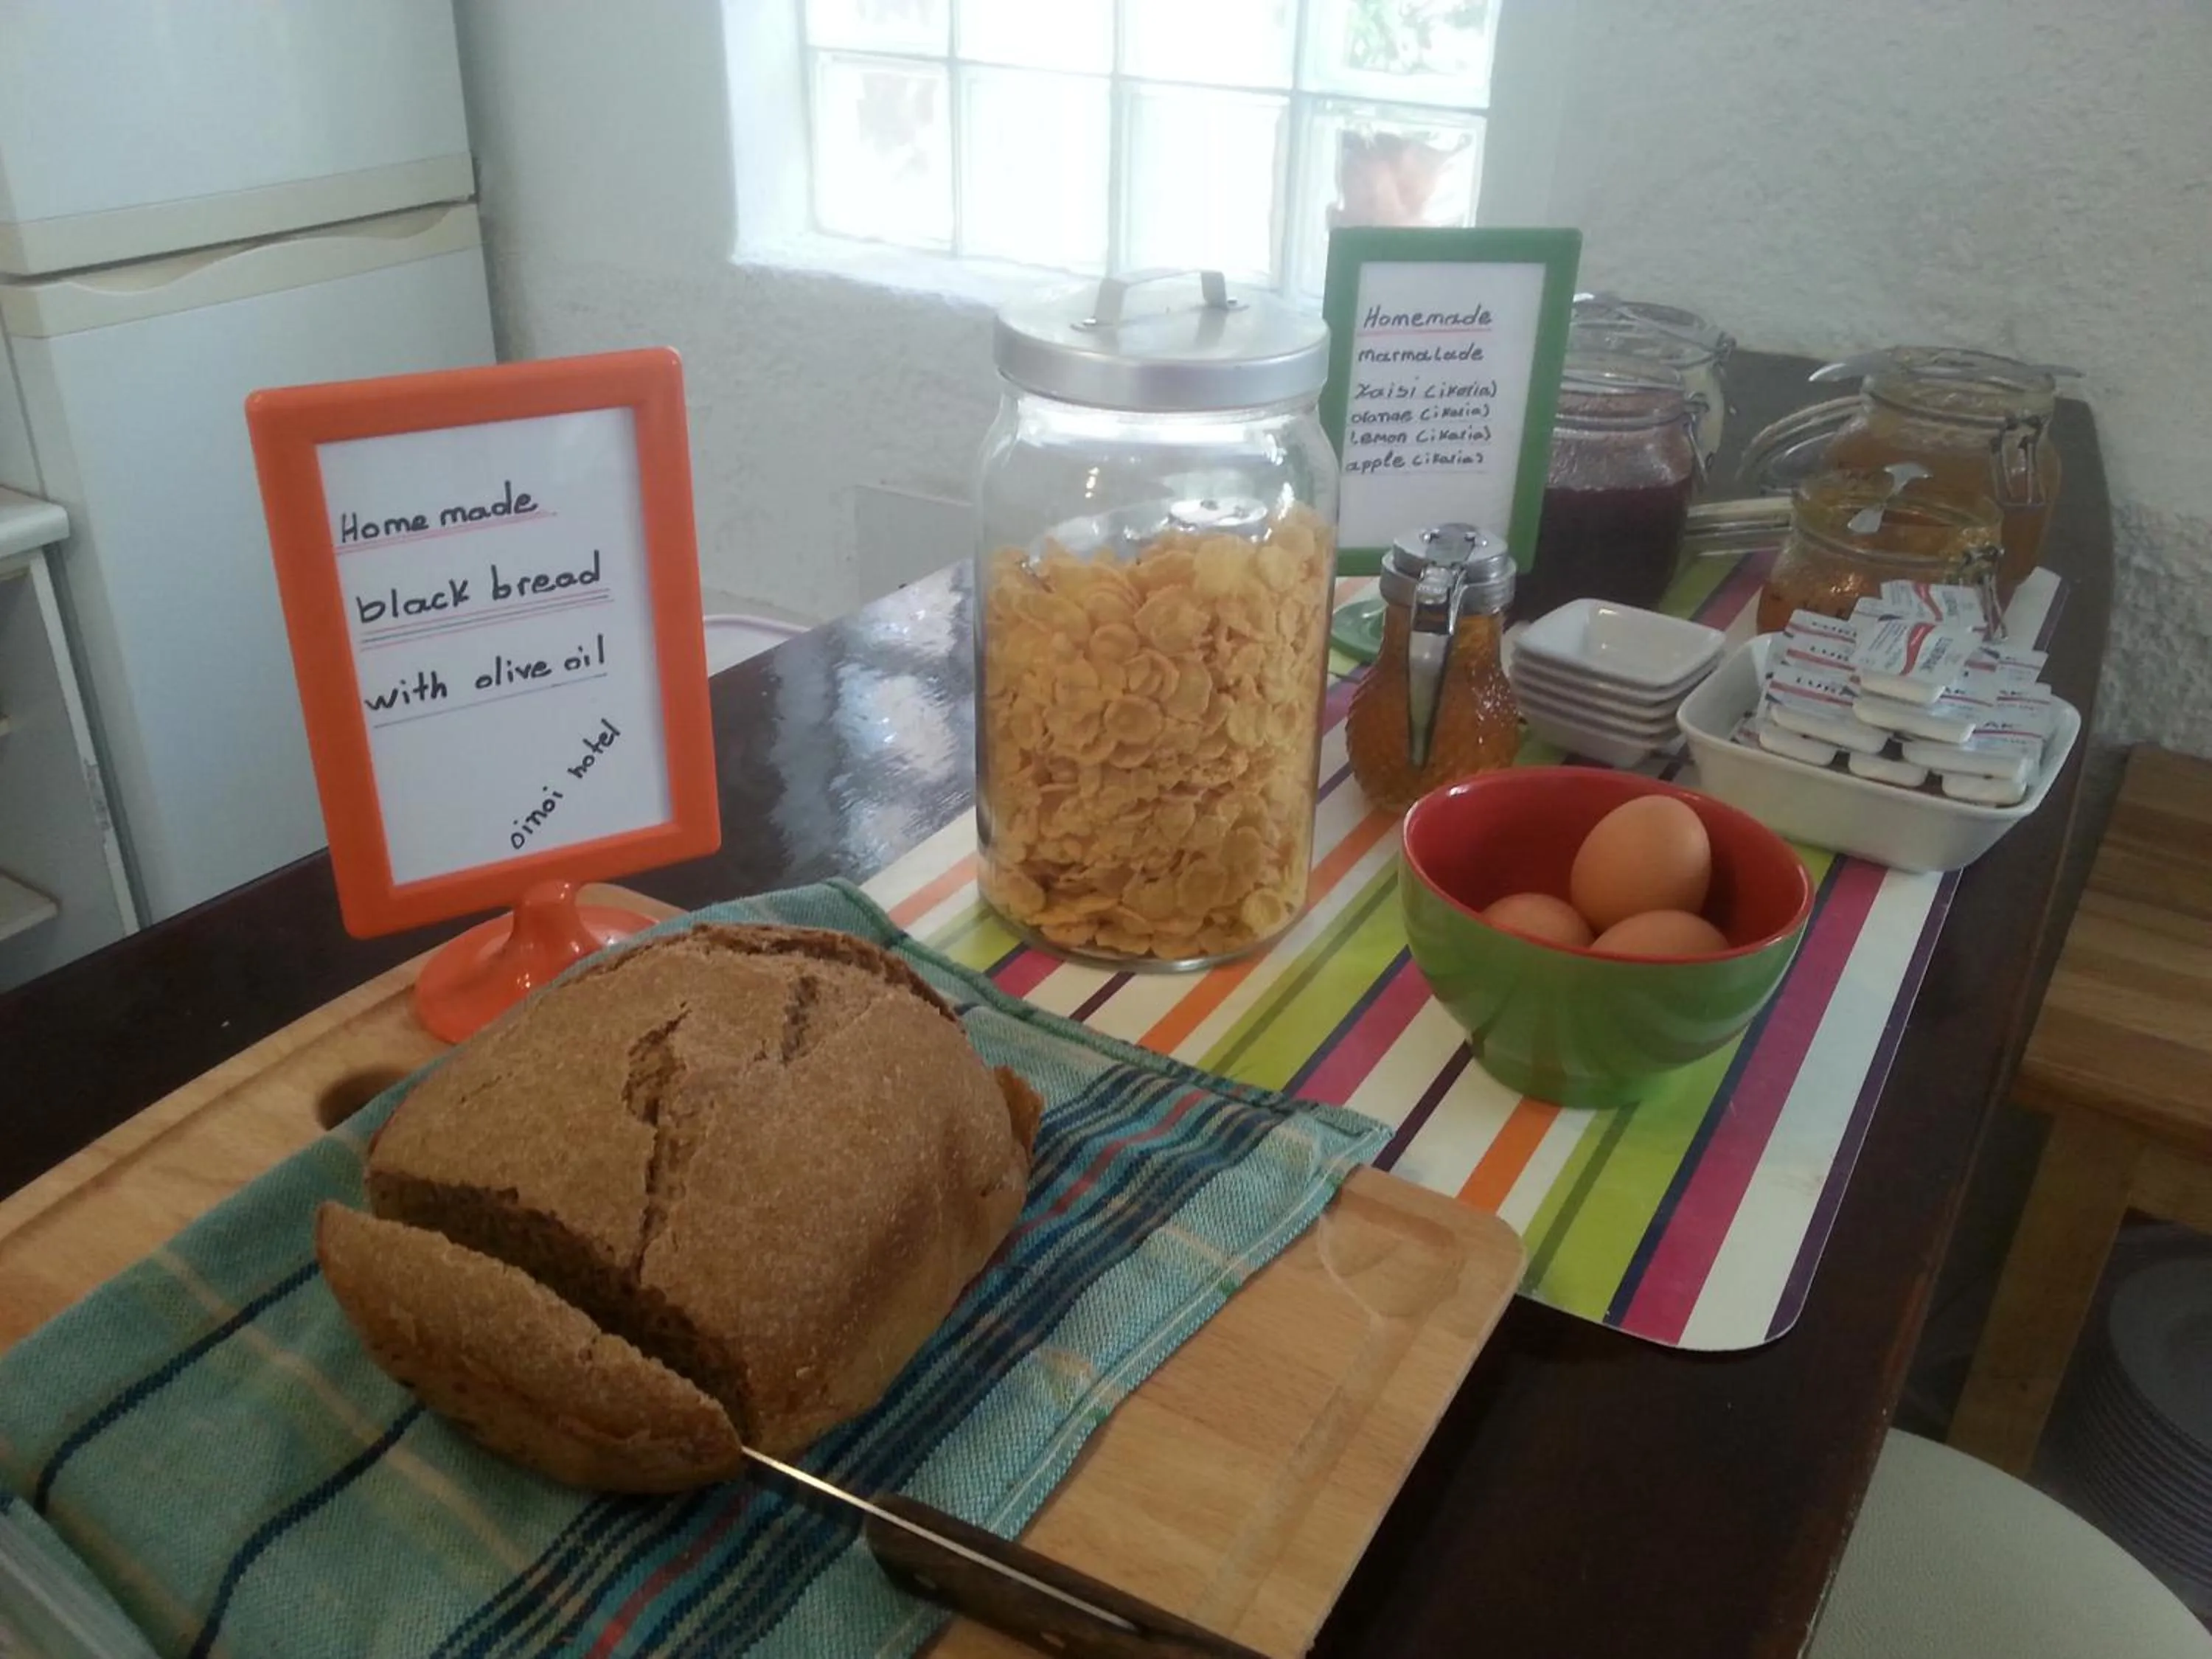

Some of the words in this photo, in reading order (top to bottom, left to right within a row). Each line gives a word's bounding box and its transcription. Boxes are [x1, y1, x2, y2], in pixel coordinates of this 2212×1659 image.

[1364, 304, 1493, 328] Homemade
[1346, 449, 1406, 473] apple
[355, 579, 470, 624] black
[491, 549, 602, 600] bread
[365, 671, 448, 710] with
[475, 655, 552, 689] olive
[563, 633, 605, 671] oil
[568, 718, 621, 779] hotel
